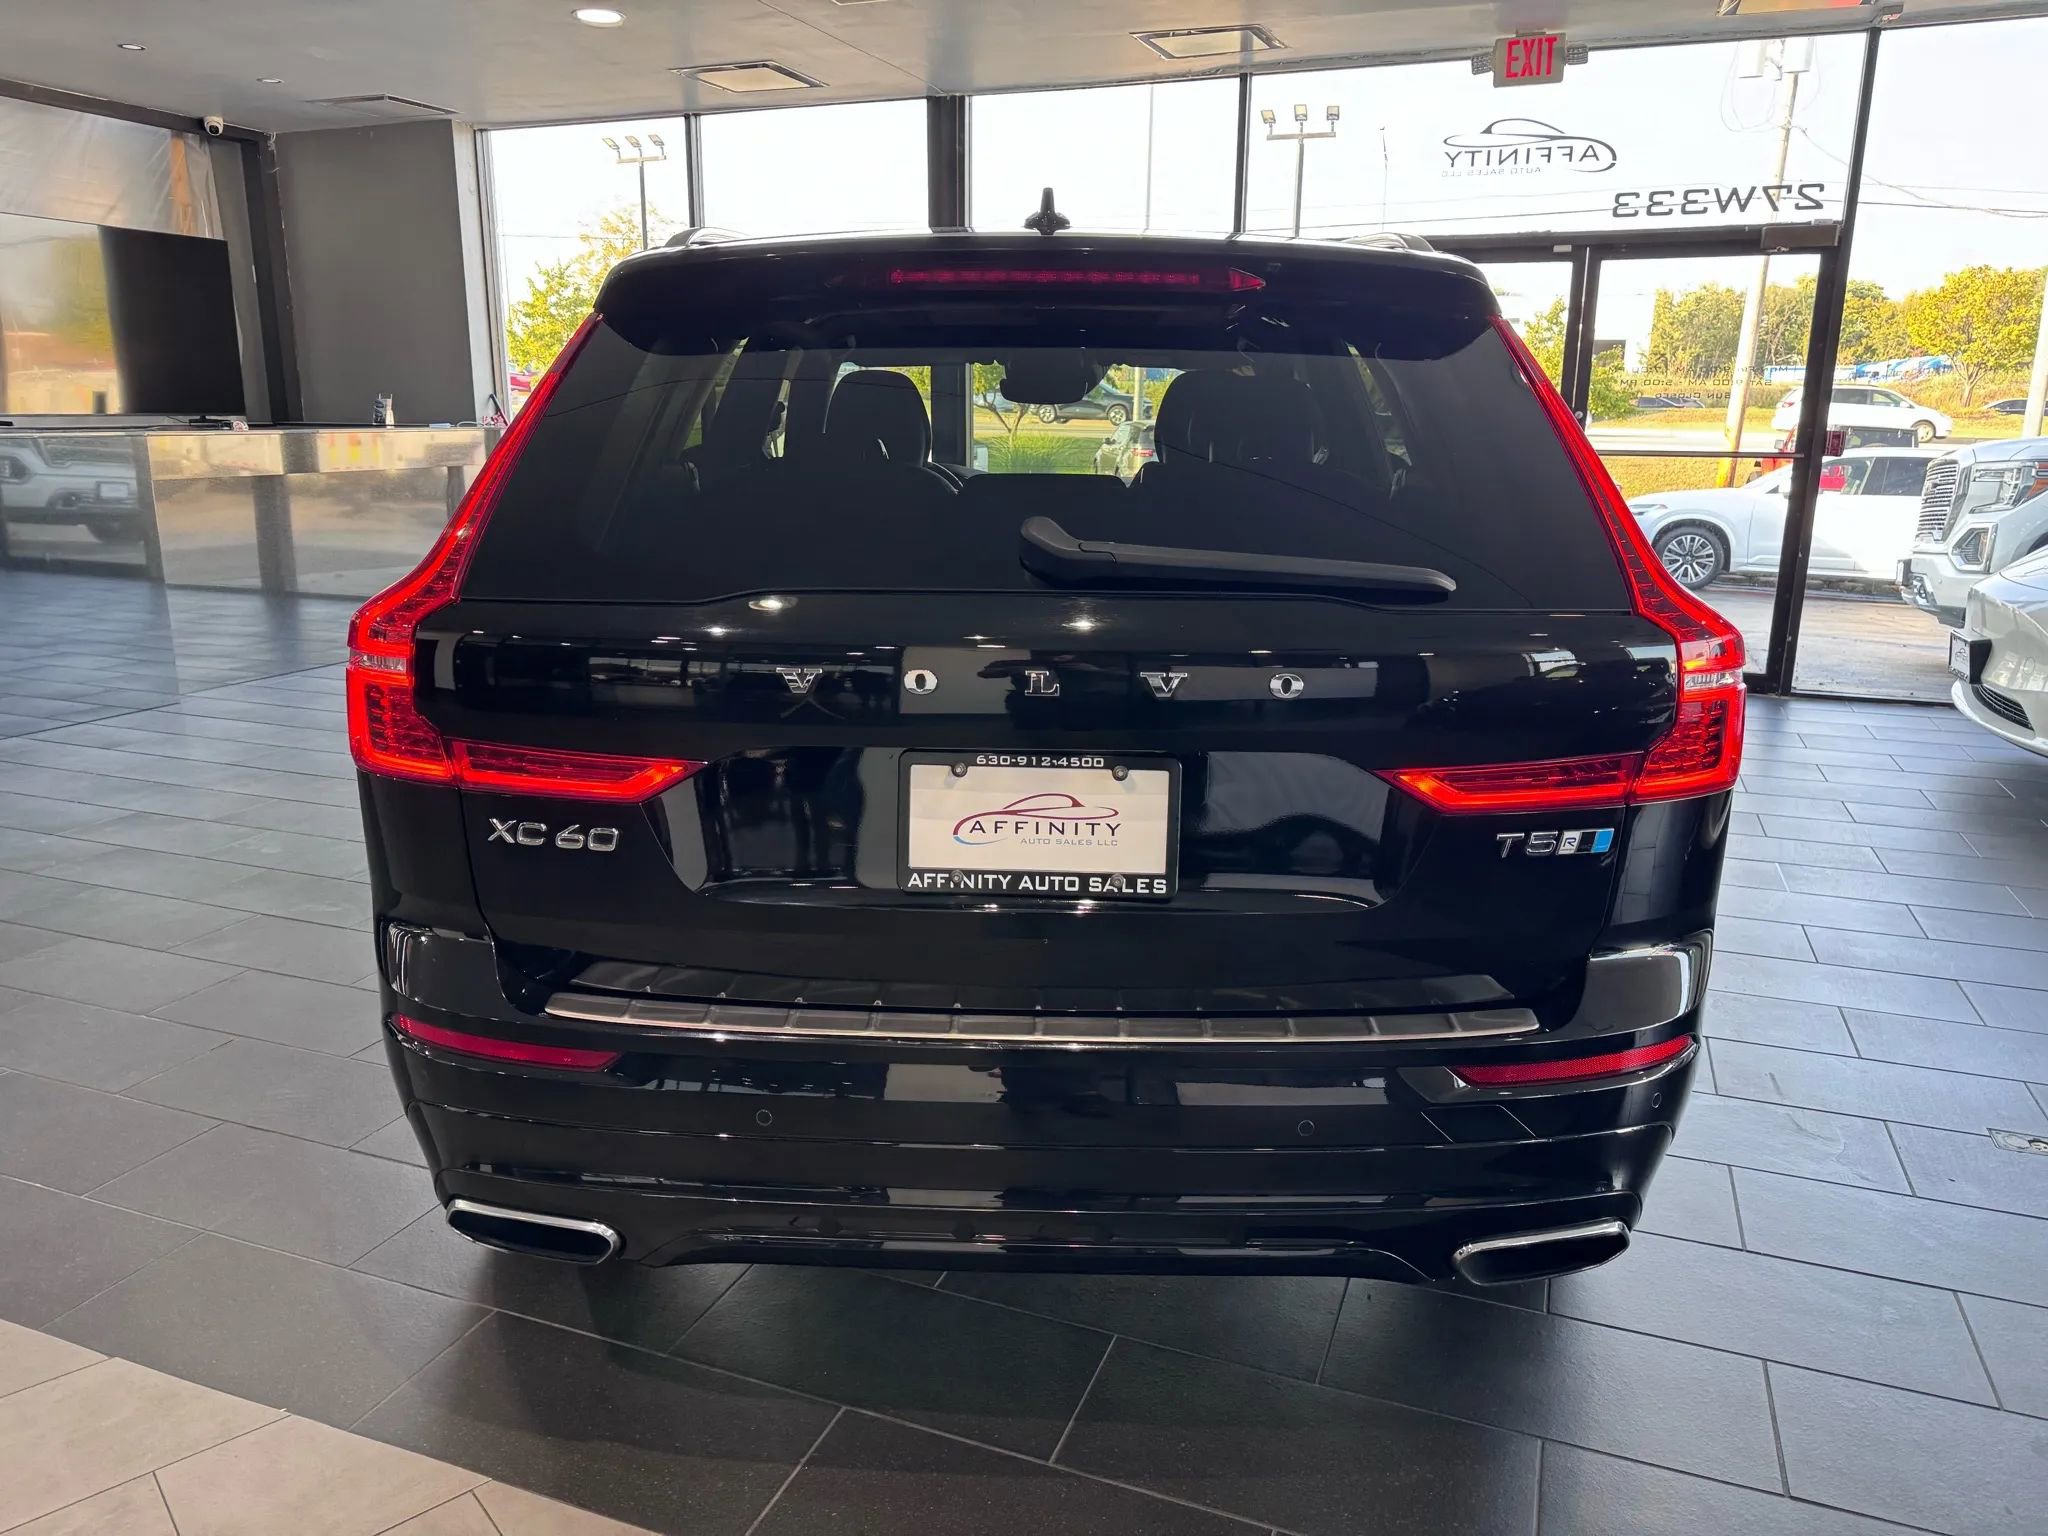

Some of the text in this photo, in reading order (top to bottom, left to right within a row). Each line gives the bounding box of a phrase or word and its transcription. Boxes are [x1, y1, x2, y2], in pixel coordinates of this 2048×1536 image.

[1504, 36, 1557, 78] EXIT
[976, 755, 1105, 767] 630-912-4500
[969, 820, 1122, 837] AFFINITY
[1020, 837, 1118, 847] AUTO SALES LLC
[1018, 875, 1080, 891] AUTO
